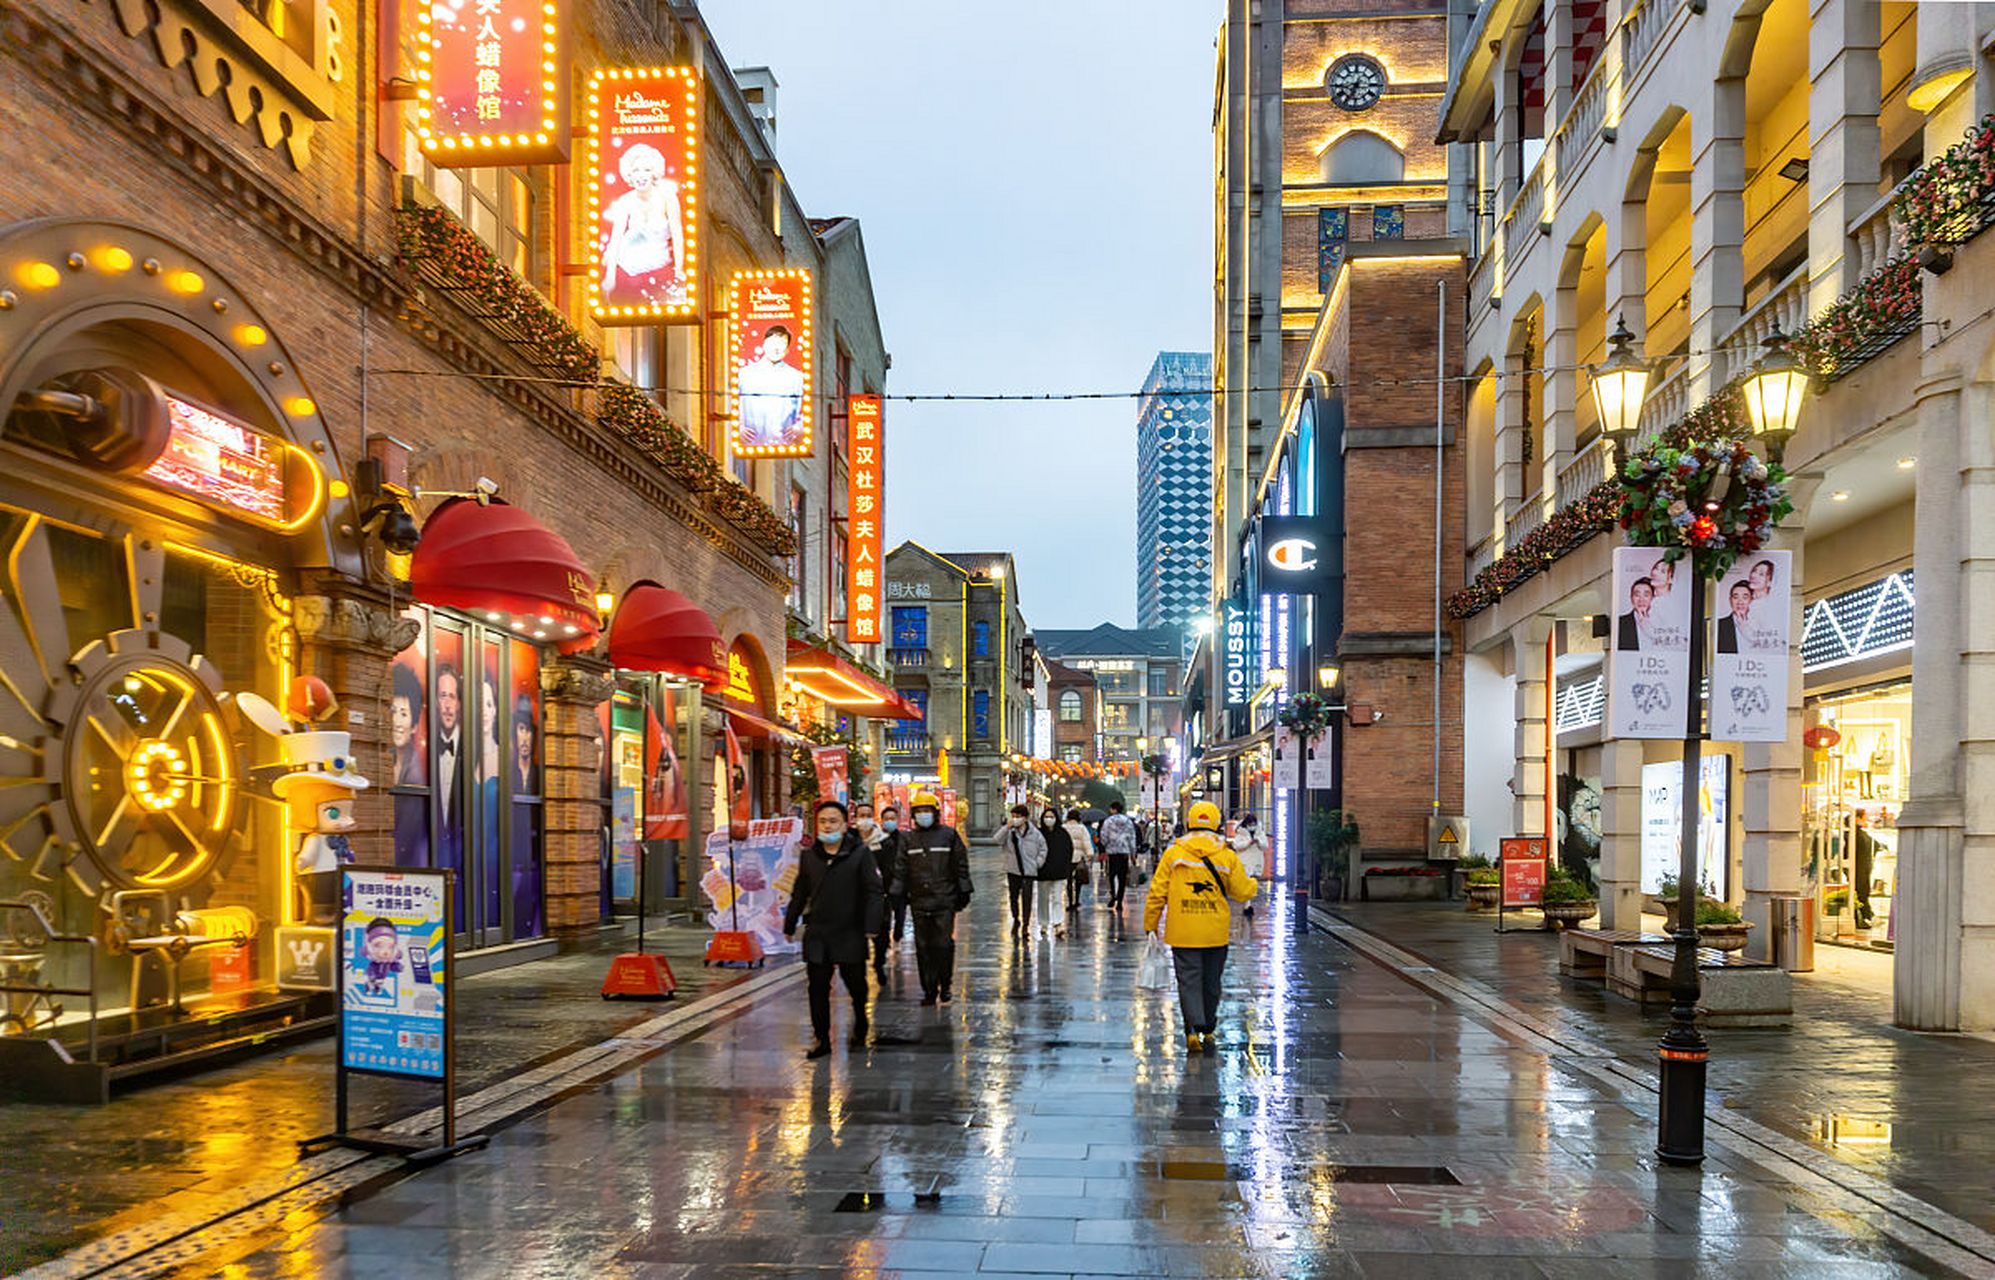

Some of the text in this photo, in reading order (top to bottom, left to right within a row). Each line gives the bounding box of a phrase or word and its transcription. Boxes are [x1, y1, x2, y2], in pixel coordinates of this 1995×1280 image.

[614, 91, 671, 109] Madame
[855, 421, 875, 637] 武汉杜莎夫人蜡像馆
[1228, 606, 1244, 704] MOUSSY
